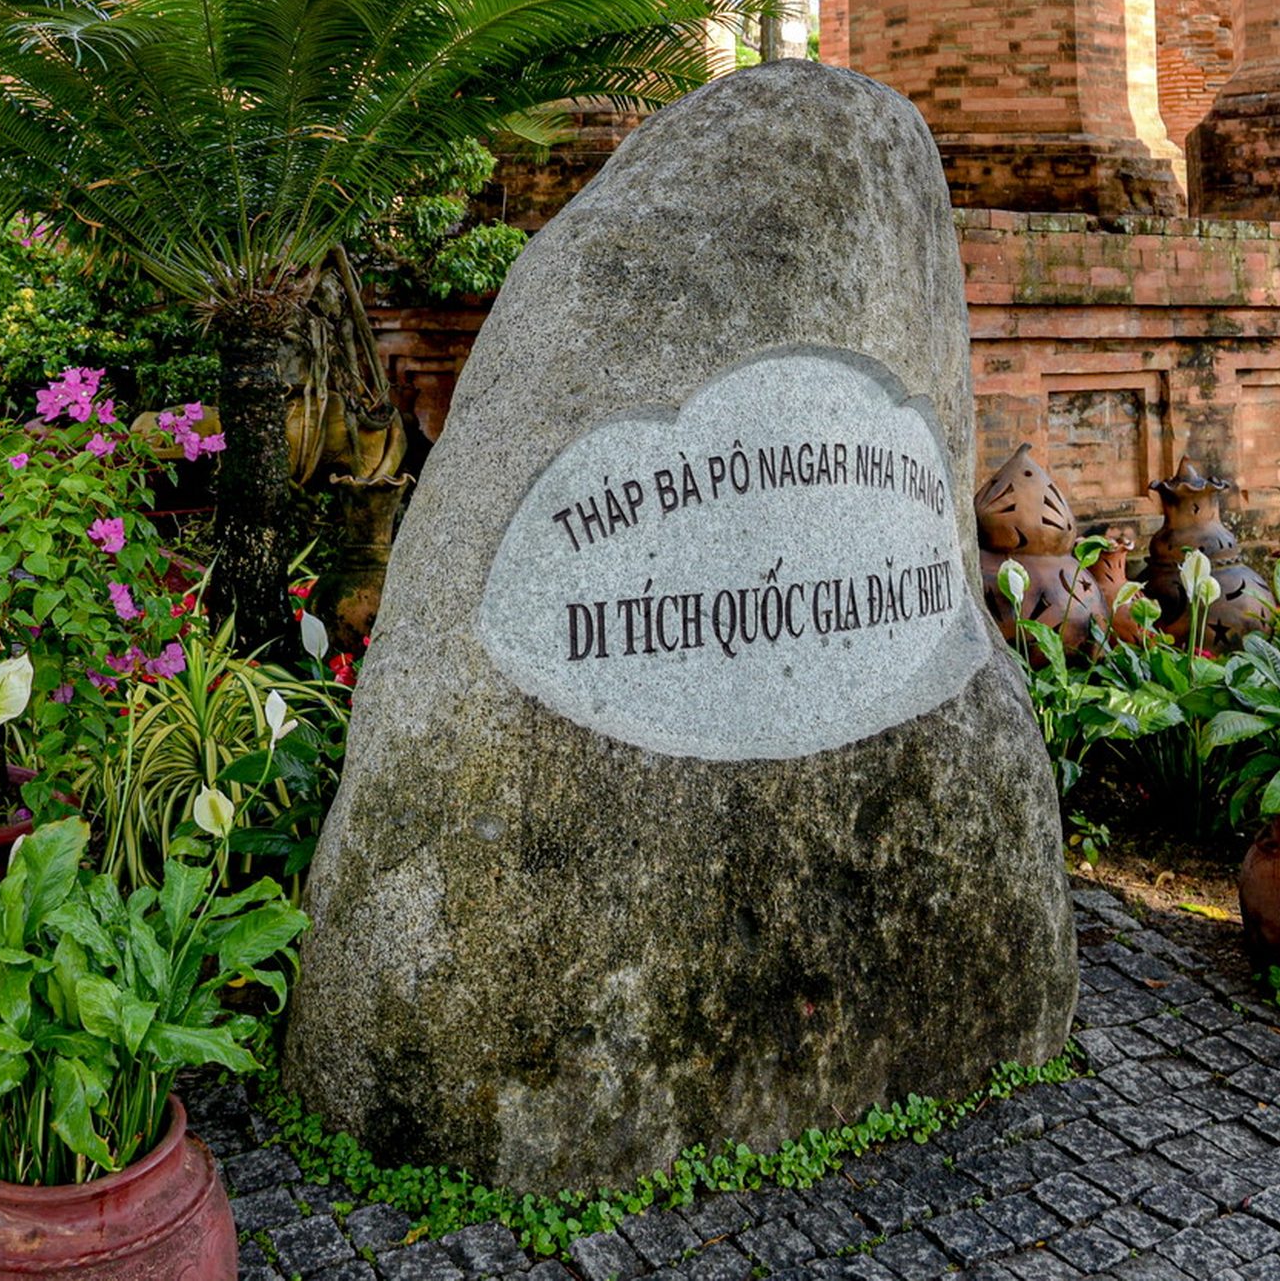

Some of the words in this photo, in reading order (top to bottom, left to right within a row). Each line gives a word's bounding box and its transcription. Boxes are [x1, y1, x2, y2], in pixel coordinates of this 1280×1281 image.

[552, 475, 644, 553] THÁP
[654, 451, 702, 513] BÀ
[708, 439, 750, 499] PÔ
[758, 442, 847, 490] NAGAR
[856, 444, 895, 491] NHA
[901, 454, 945, 515] TRANG
[566, 601, 609, 661] DI
[616, 578, 705, 656] TÍCH
[712, 557, 805, 659] QUỐC
[812, 577, 862, 635] GIA
[867, 555, 913, 640] ĐẶC
[917, 547, 953, 627] BIỆT
